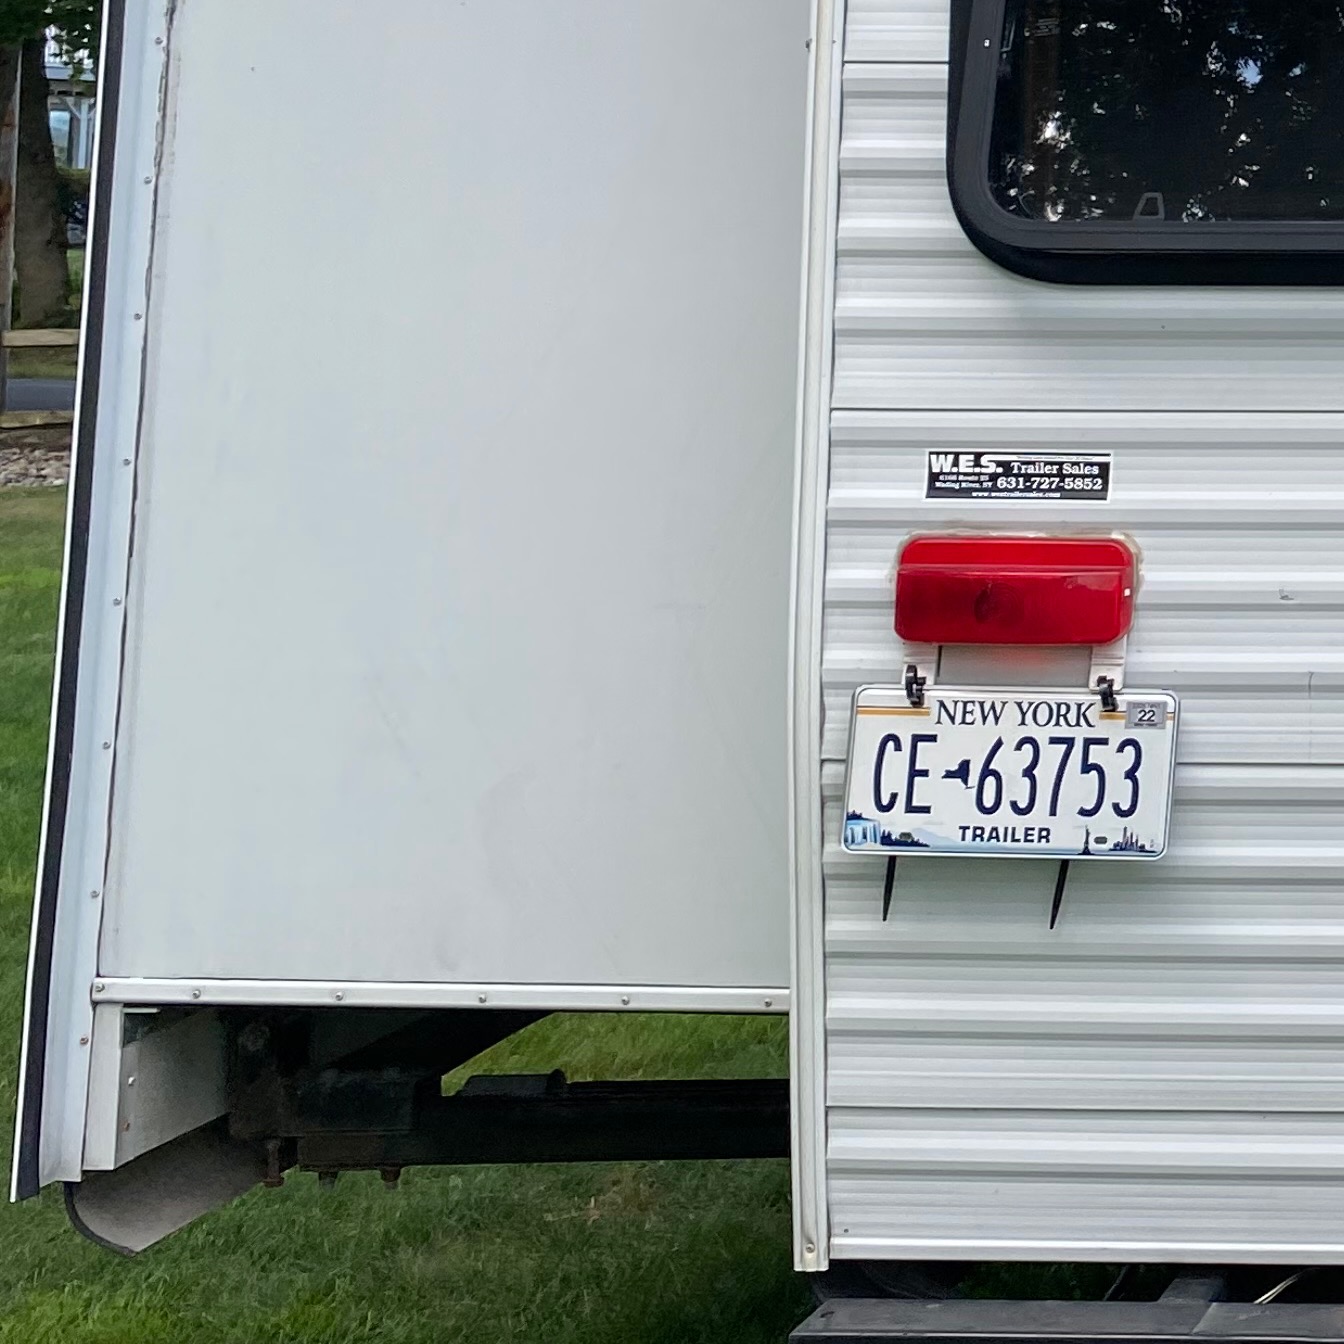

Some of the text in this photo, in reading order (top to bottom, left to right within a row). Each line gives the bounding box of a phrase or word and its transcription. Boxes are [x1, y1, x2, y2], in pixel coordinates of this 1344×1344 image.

[930, 455, 1003, 473] W.E.S.
[1010, 462, 1060, 474] Trailer
[1062, 463, 1099, 474] Sales
[996, 476, 1103, 490] 631-727-5852
[935, 700, 1096, 728] NEW YORK
[1137, 709, 1156, 722] 22
[958, 825, 1051, 844] TRAILER
